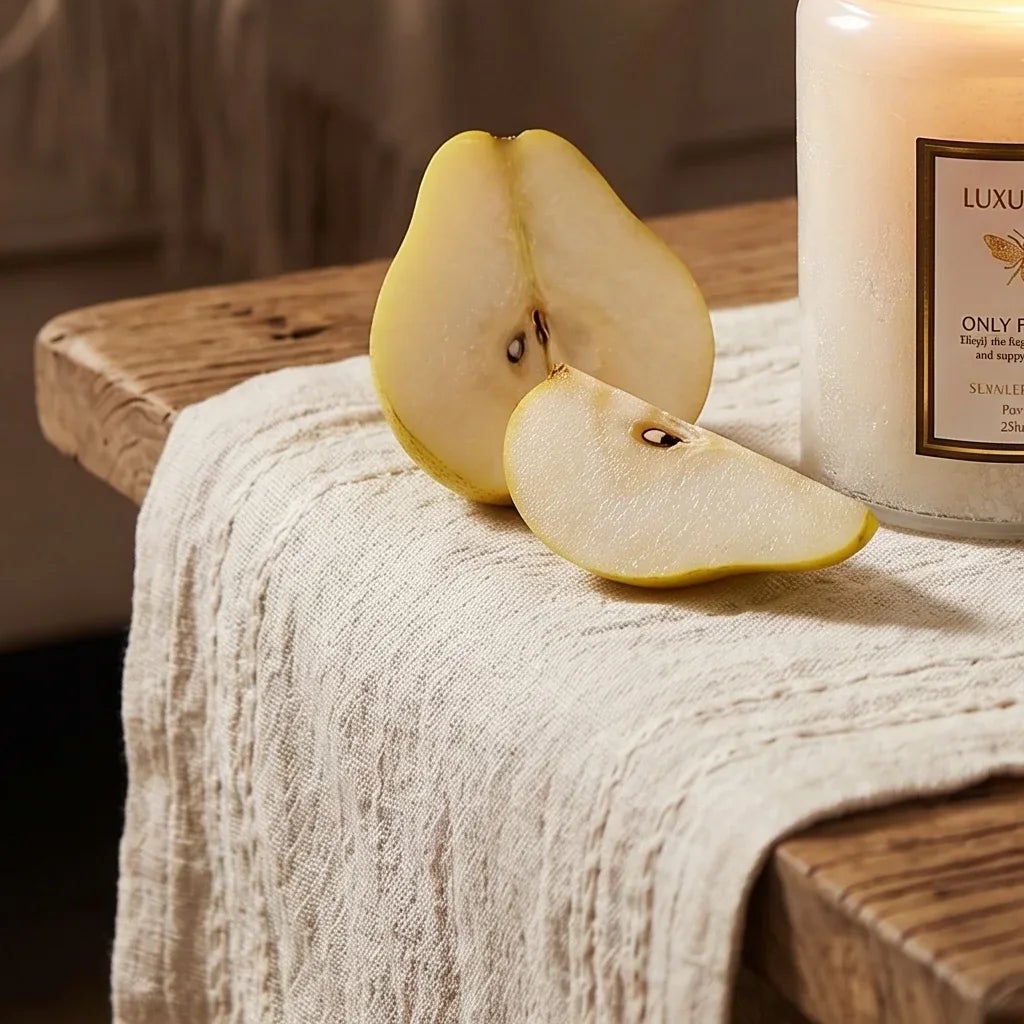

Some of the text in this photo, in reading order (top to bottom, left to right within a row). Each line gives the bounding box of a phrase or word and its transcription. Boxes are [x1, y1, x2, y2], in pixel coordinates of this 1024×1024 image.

[962, 316, 1011, 333] ONLY
[975, 350, 994, 360] and
[996, 353, 1024, 363] suppy
